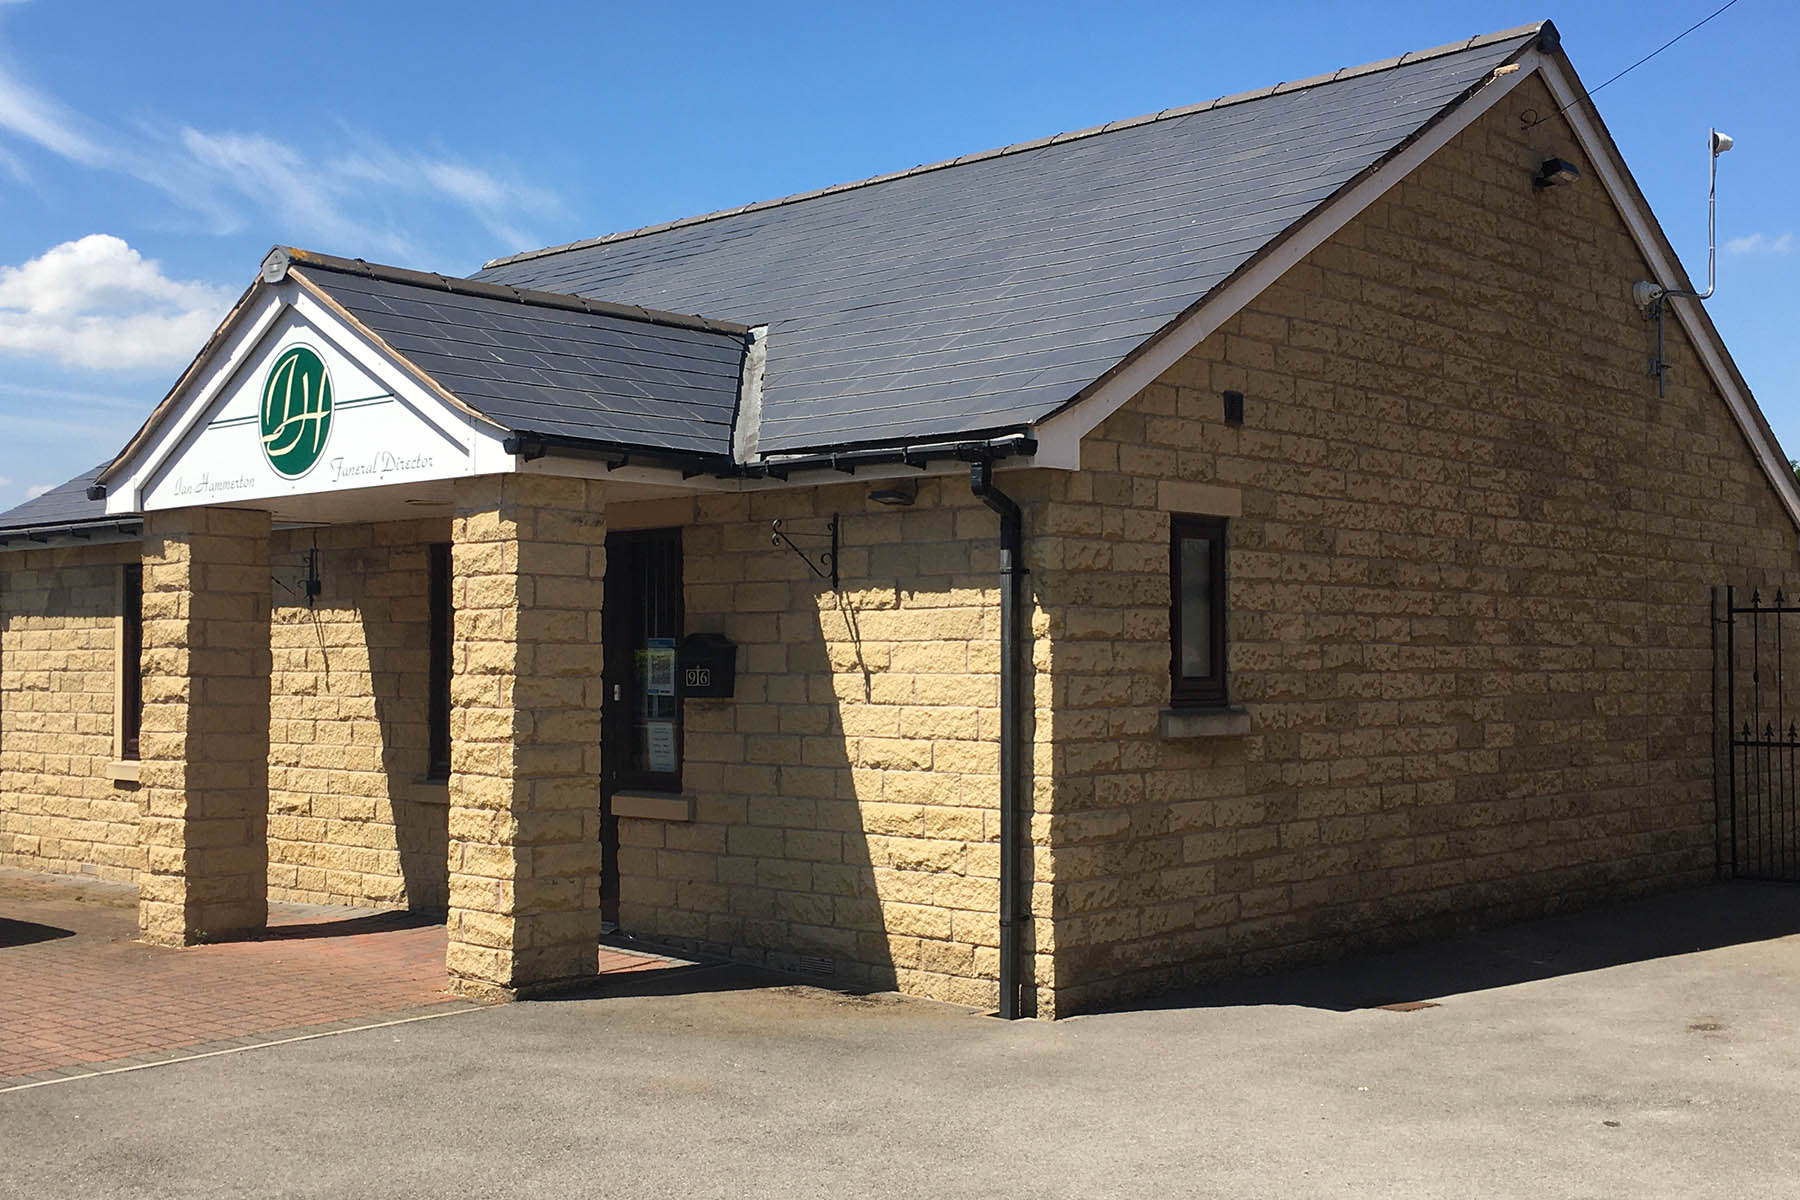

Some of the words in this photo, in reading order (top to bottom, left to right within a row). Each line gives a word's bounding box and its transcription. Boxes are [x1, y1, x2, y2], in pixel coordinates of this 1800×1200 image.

[330, 451, 380, 482] Funeral
[381, 451, 433, 473] Director
[173, 476, 193, 496] Ian
[193, 472, 255, 493] Hammerton
[688, 671, 708, 685] 96
